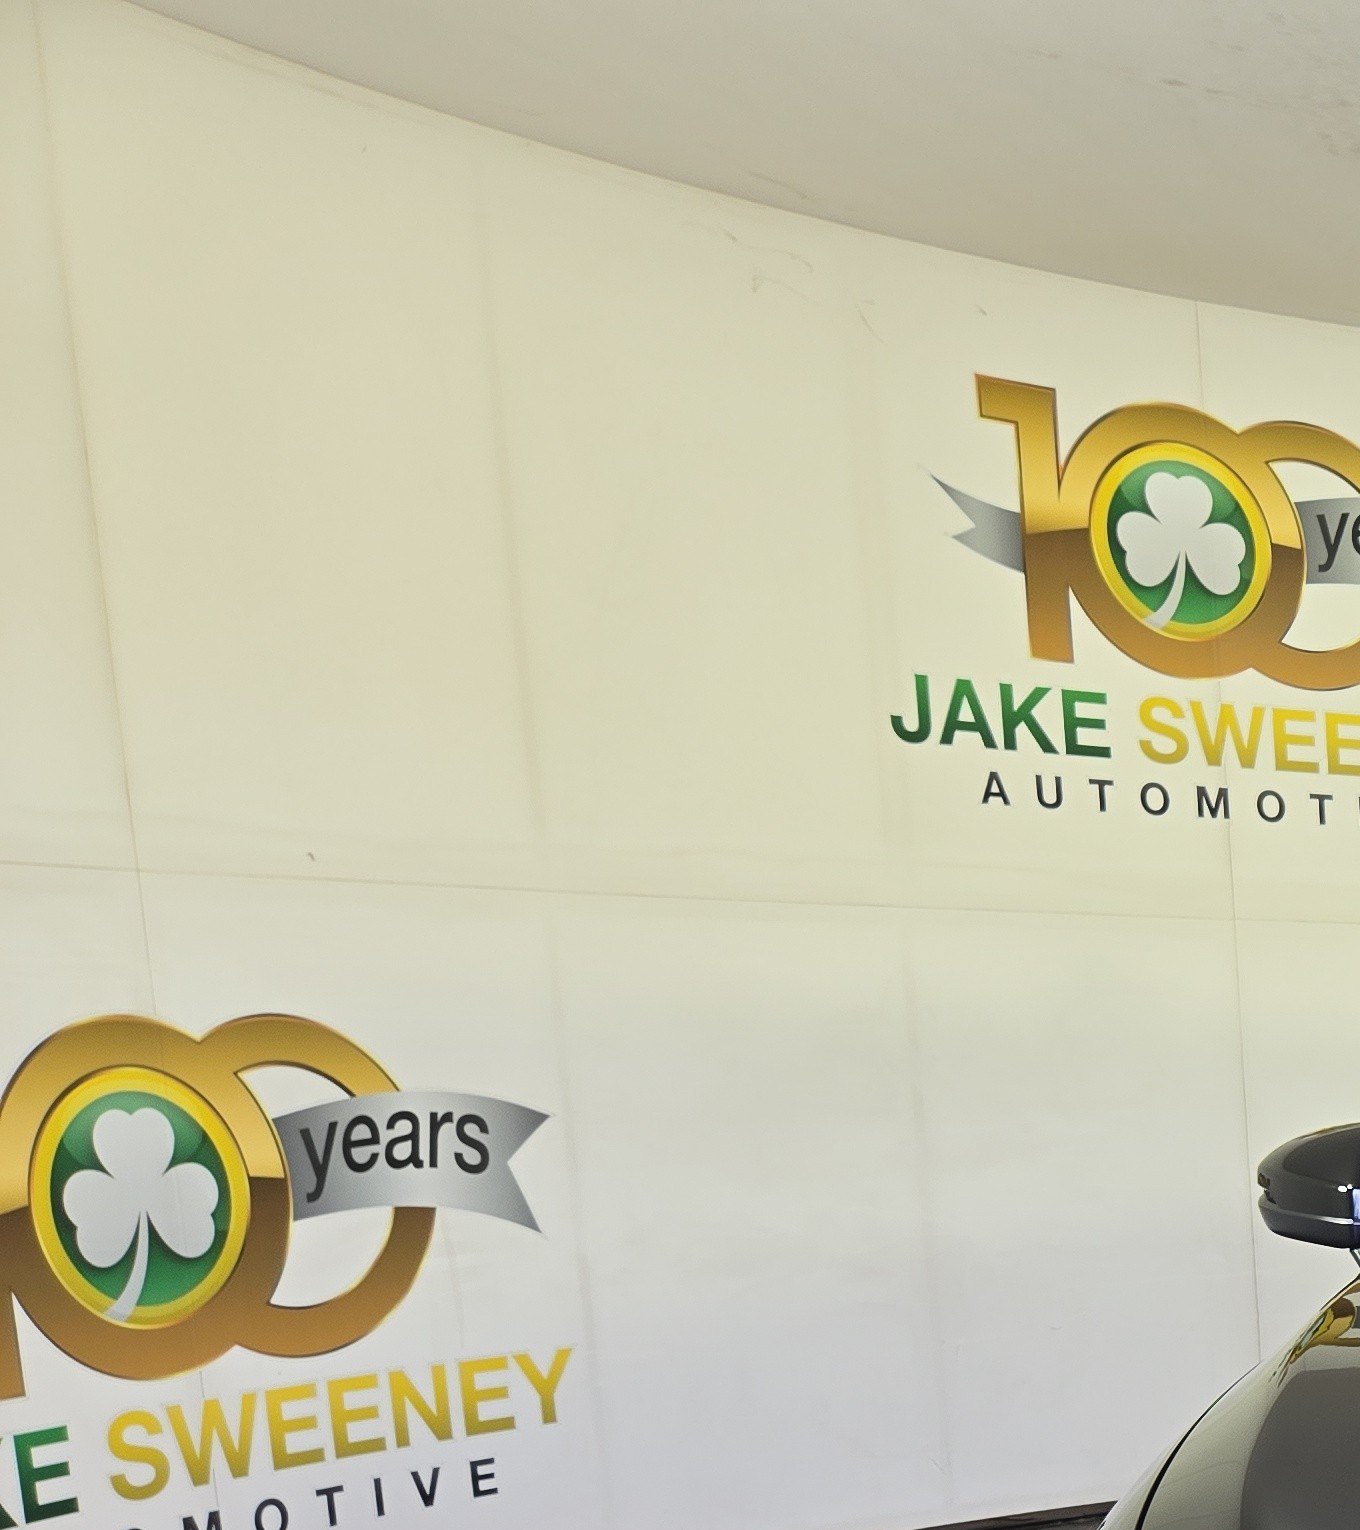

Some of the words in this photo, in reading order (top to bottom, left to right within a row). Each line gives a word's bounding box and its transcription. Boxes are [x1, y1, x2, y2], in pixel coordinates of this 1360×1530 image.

[889, 671, 1113, 759] JAKE
[0, 1012, 437, 1399] 00
[299, 1109, 491, 1203] years
[106, 1347, 575, 1502] SWEENEY
